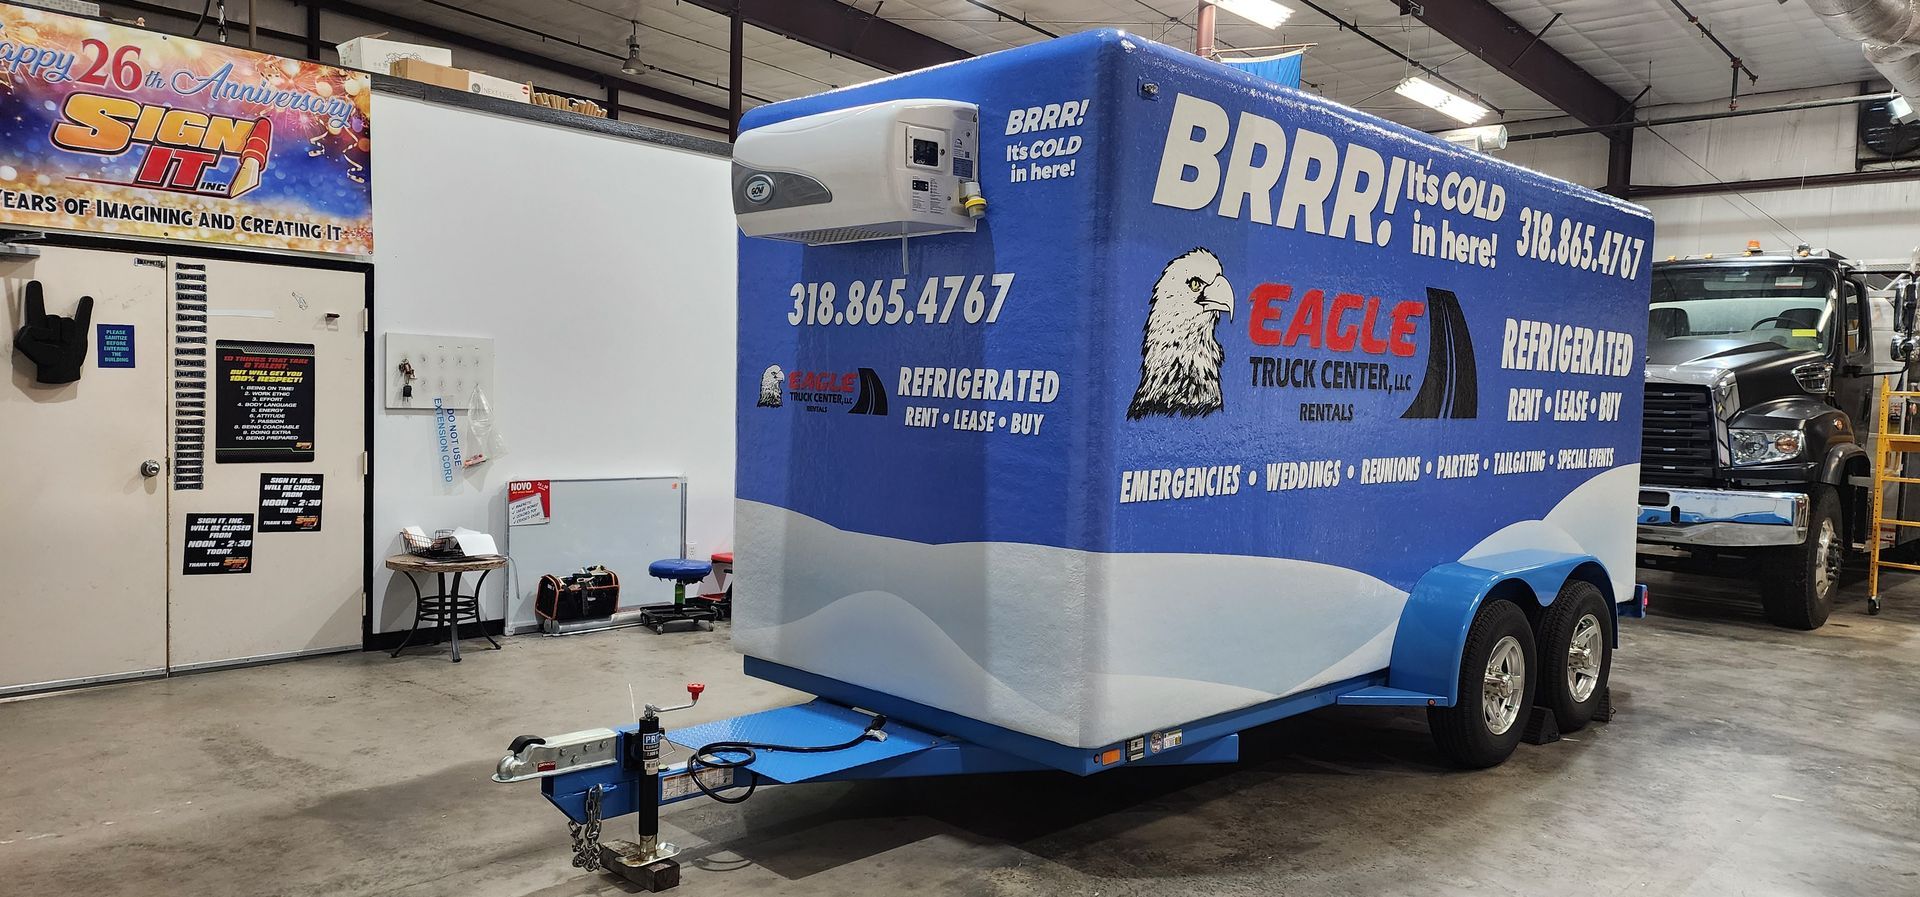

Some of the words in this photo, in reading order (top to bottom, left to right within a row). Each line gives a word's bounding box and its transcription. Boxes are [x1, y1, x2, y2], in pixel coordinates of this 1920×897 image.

[0, 41, 75, 82] appy
[171, 62, 353, 129] Anniversary
[52, 94, 254, 156] SIGN
[1005, 99, 1090, 136] BRRR!
[1007, 141, 1028, 162] It's
[1030, 135, 1083, 160] COLD
[138, 147, 217, 188] IT
[1011, 163, 1027, 183] in
[1031, 159, 1076, 181] here!
[1152, 92, 1407, 248] BRRR!
[200, 181, 227, 192] INC
[1406, 158, 1440, 206] It's
[1441, 171, 1507, 223] COLD
[64, 198, 90, 215] OF
[96, 199, 193, 226] IMAGINING
[199, 212, 235, 230] AND
[241, 215, 322, 239] CREATING
[327, 224, 342, 241] IT
[1412, 209, 1436, 257] in
[1441, 219, 1498, 270] here!
[1516, 206, 1645, 281] 318.865.4767
[787, 272, 1016, 326] 318.865.4767
[1248, 282, 1426, 358] EAGLE
[1501, 318, 1634, 377] REFRIGERATED
[788, 371, 859, 393] EAGLE
[898, 366, 1060, 404] REFRIGERATED
[1250, 356, 1317, 389] TRUCK
[1320, 360, 1393, 395] CENTER,
[1394, 374, 1412, 392] LLC
[446, 408, 456, 422] DO
[790, 392, 812, 402] TRUCK
[844, 397, 853, 405] LLC
[806, 405, 828, 413] RENTALS
[1300, 403, 1354, 422] RENTALS
[1507, 388, 1543, 422] RENT
[1554, 389, 1590, 422] LEASE
[1598, 391, 1623, 422] BUY
[434, 398, 449, 453] EXTENSION
[449, 424, 460, 444] NOT
[905, 406, 940, 428] RENT
[953, 409, 996, 432] LEASE
[1010, 413, 1045, 436] BUY
[441, 455, 453, 483] CORD
[452, 447, 462, 467] USE
[1119, 465, 1241, 503] EMERGENCIES
[1266, 460, 1342, 492] WEDDINGS
[1360, 456, 1421, 485] REUNIONS
[1436, 453, 1480, 480] PARTIES
[1493, 450, 1547, 475] TAILGATING
[1557, 449, 1588, 470] SPECIAL
[1588, 447, 1615, 468] EVENTS
[511, 482, 532, 491] NOVO
[226, 540, 252, 548] 2:30
